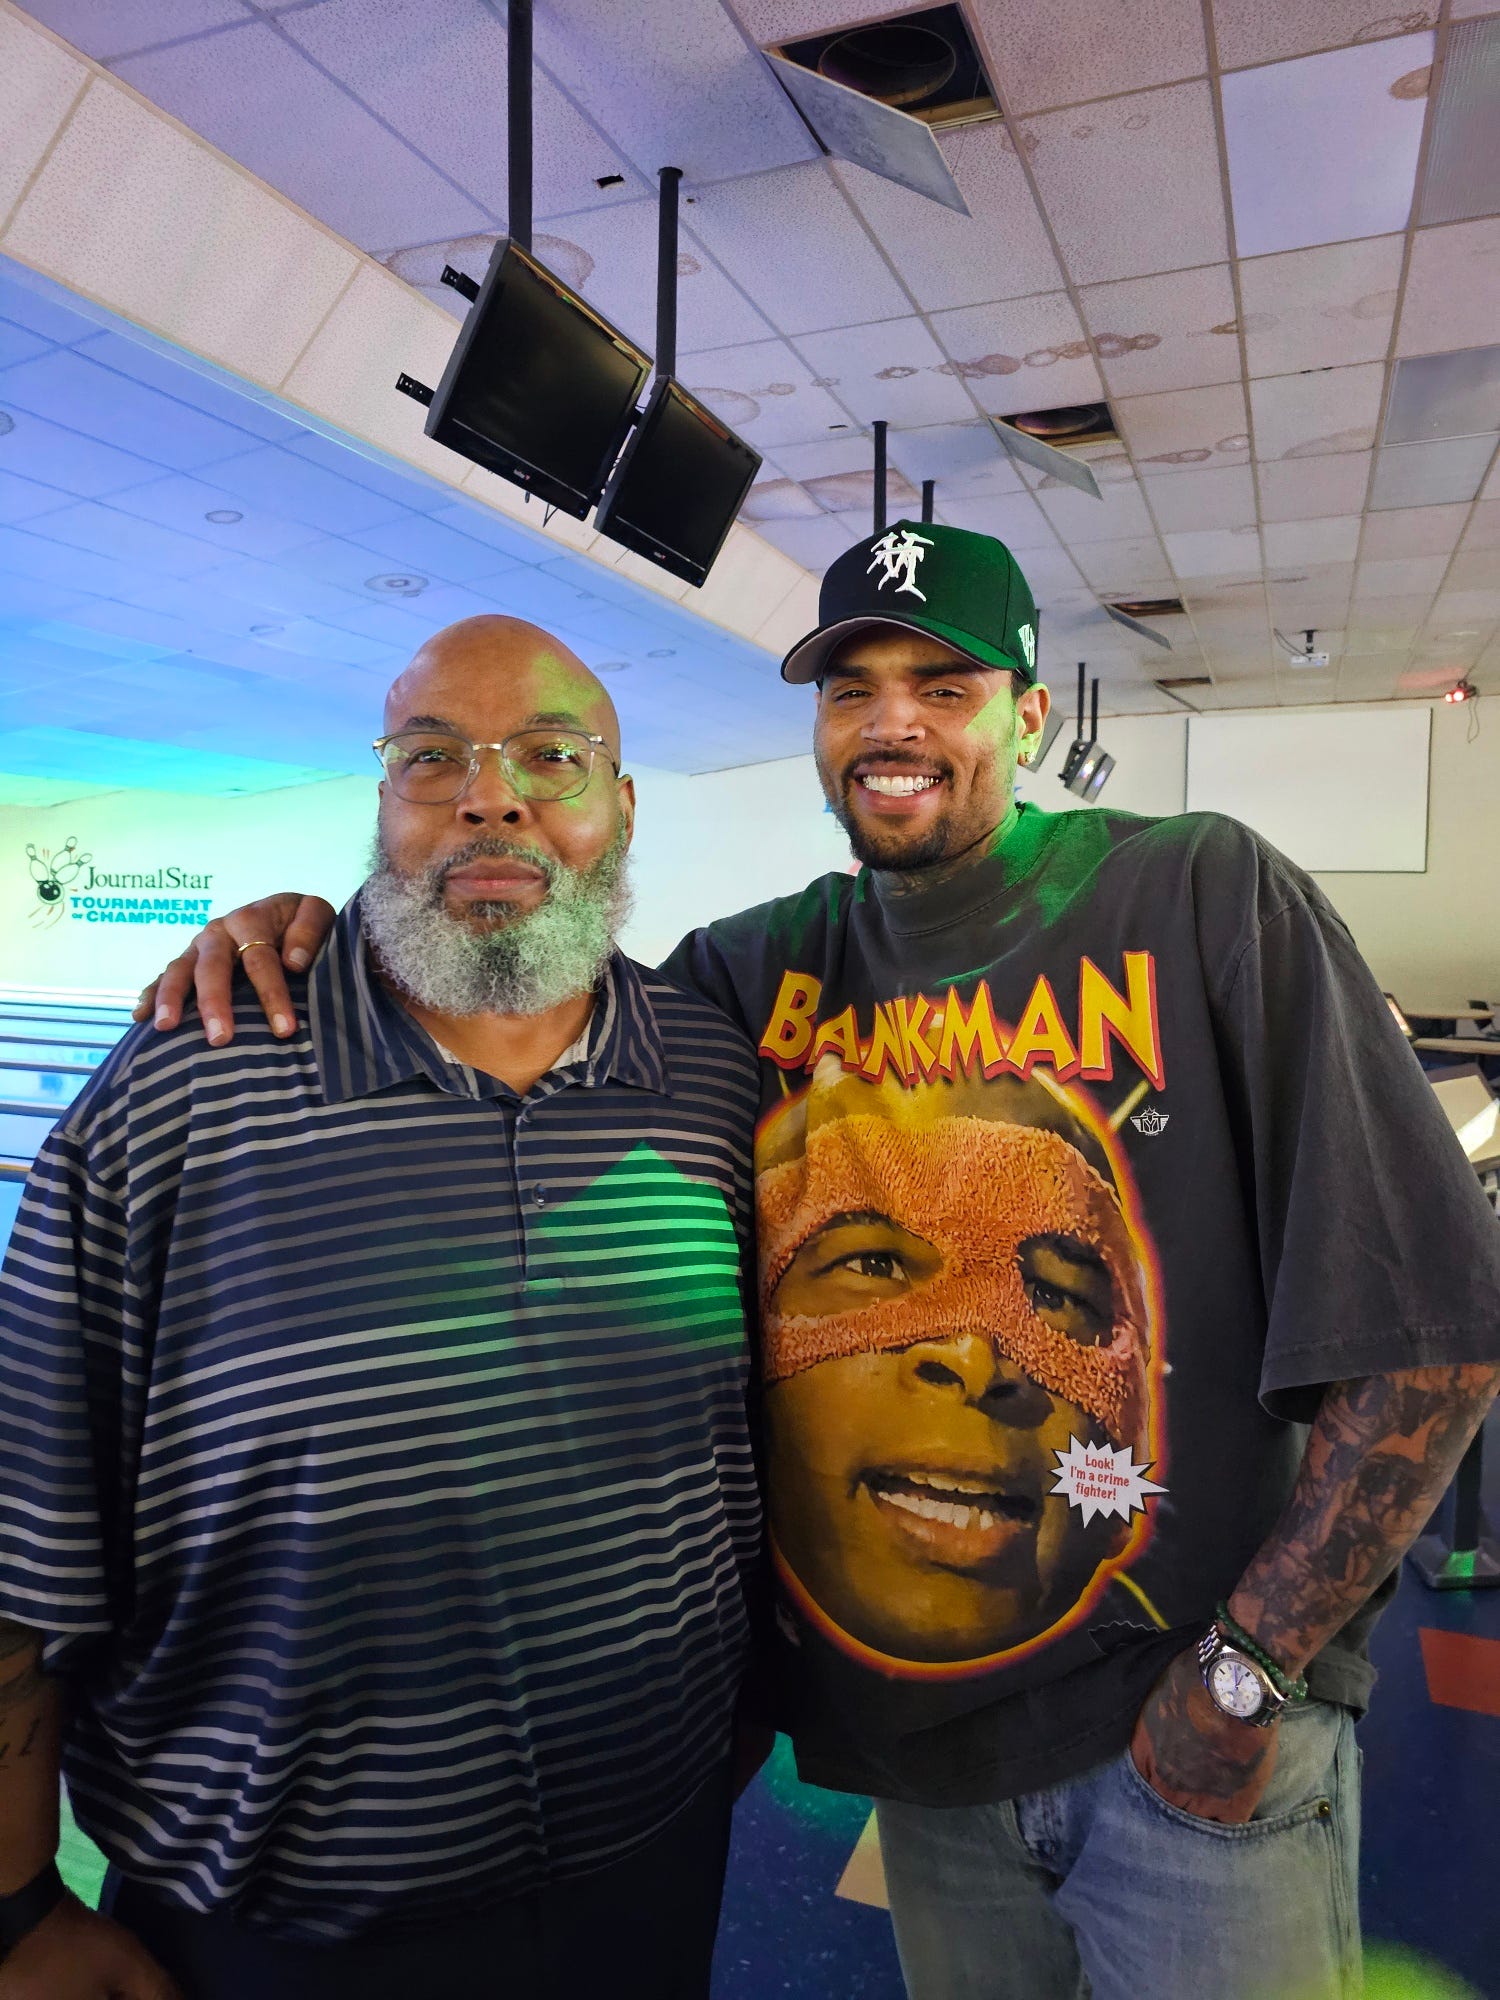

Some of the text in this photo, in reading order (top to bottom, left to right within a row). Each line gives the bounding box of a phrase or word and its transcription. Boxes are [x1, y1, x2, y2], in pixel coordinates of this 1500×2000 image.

[70, 896, 212, 911] TOURNAMENT
[86, 910, 209, 926] CHAMPIONS
[758, 950, 1166, 1091] BANKMAN
[1085, 1454, 1114, 1471] Look!
[1070, 1465, 1130, 1487] I'm a crime
[1075, 1482, 1117, 1501] fighter!
